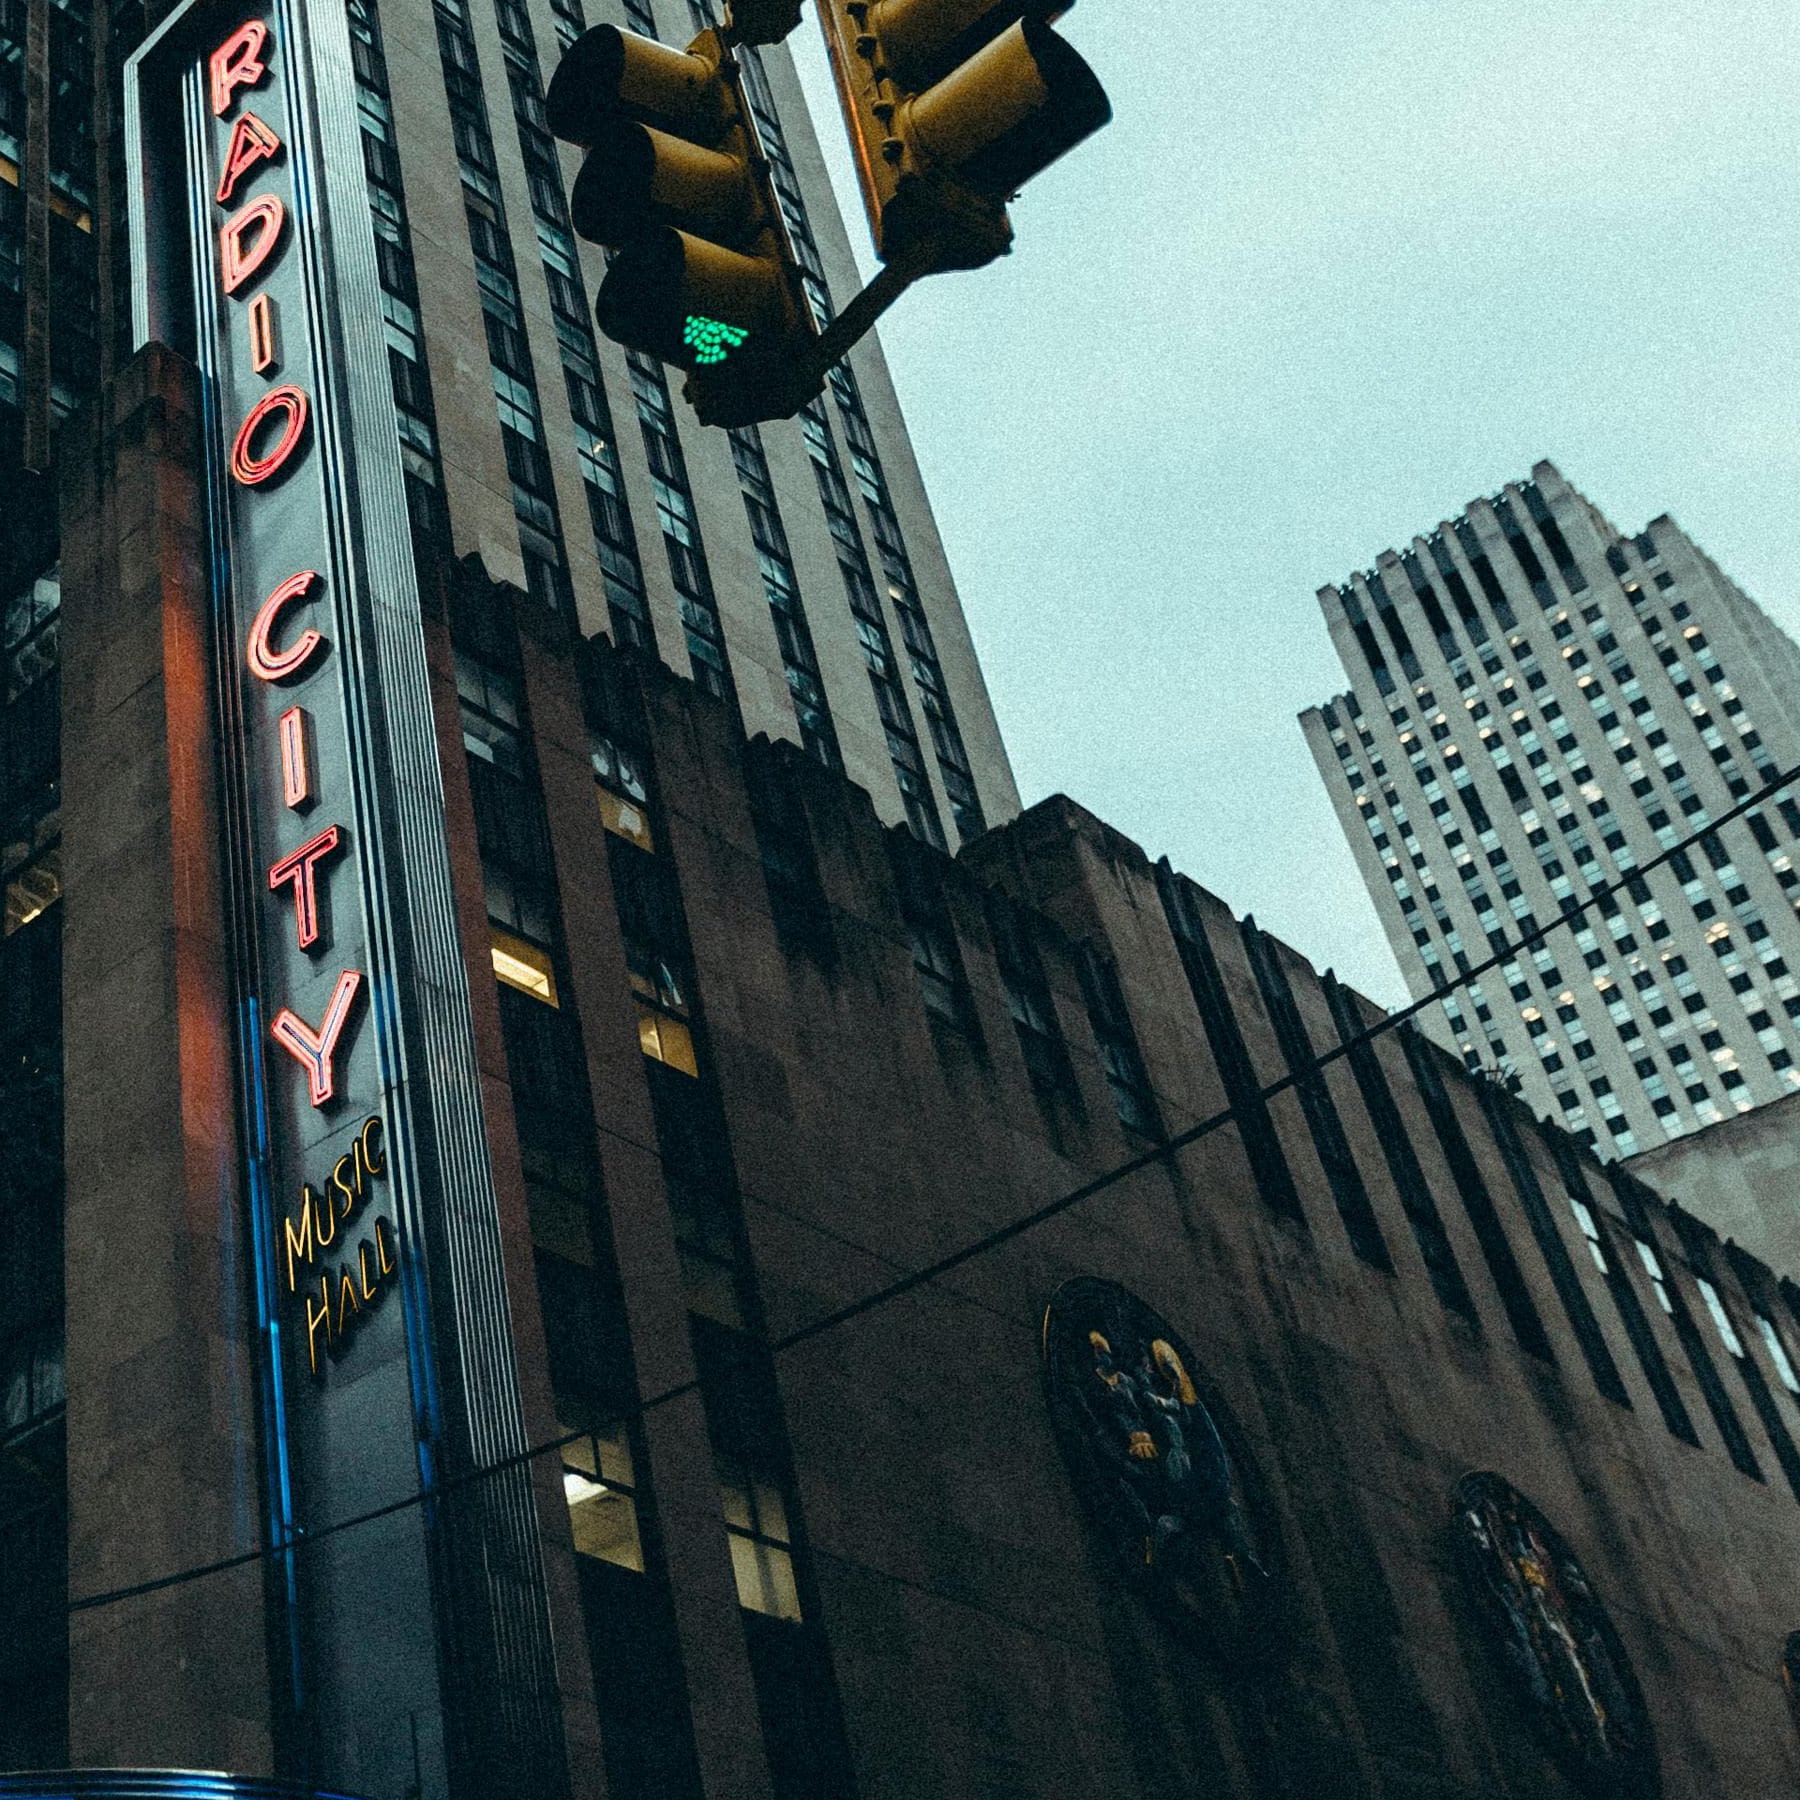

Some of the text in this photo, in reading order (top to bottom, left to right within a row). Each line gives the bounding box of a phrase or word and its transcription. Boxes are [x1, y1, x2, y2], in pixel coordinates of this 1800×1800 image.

[209, 19, 307, 486] RADIO
[246, 568, 362, 1108] CITY
[285, 1118, 385, 1292] MUSIC
[306, 1223, 396, 1375] HALL
